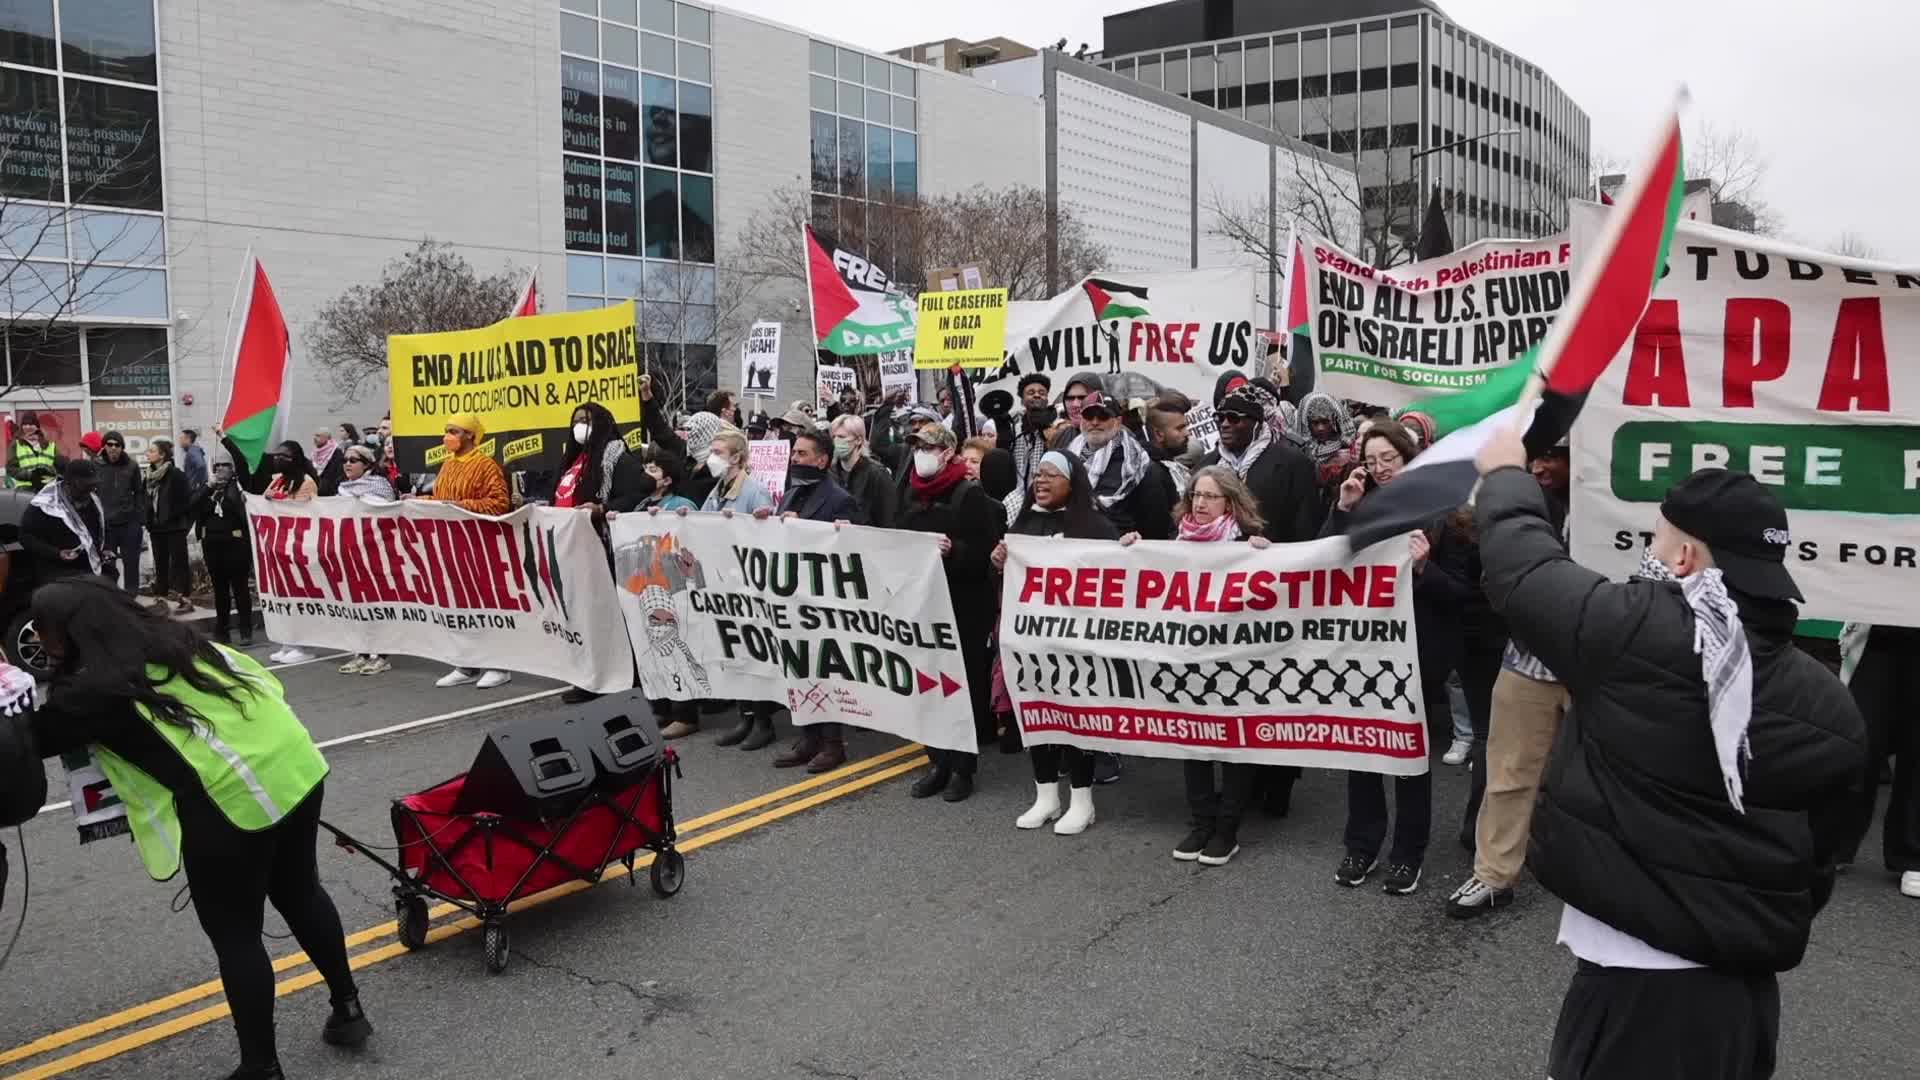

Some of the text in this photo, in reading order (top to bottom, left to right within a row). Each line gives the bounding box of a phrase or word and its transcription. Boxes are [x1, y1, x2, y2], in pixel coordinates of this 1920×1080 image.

[563, 89, 580, 105] my
[67, 126, 91, 138] was
[94, 128, 142, 144] possible
[563, 107, 627, 132] Mastes in
[563, 129, 600, 150] Public
[564, 159, 633, 182] Adminiration
[564, 181, 575, 196] in
[577, 182, 591, 199] 18
[565, 206, 588, 221] and
[565, 228, 628, 247] graduted
[1314, 246, 1375, 279] Stand
[1436, 249, 1552, 288] Palestinian
[921, 296, 944, 312] FULL
[947, 293, 1003, 310] CEASEFIRE
[1319, 268, 1364, 312] END
[1373, 285, 1424, 324] ALL
[1434, 284, 1482, 323] U.S.
[938, 314, 981, 330] IN GAZA
[943, 335, 974, 350] NOW!
[1029, 323, 1102, 372] WILL
[1128, 321, 1200, 363] FREE
[1208, 320, 1251, 367] US
[1354, 316, 1463, 366] ISRAELI
[412, 354, 452, 387] END
[457, 351, 485, 385] ALL
[504, 338, 546, 377] AID
[549, 335, 583, 374] TO
[1325, 357, 1488, 388] PARTY FOR SOCIALISM
[413, 373, 636, 416] NO TO OCCUPATON & APARTHEI
[427, 447, 452, 461] ANSW
[1639, 442, 1843, 487] FREE
[318, 515, 532, 612] PALESTINE!
[1839, 544, 1917, 568] FOR
[733, 545, 868, 600] YOUTH
[1019, 565, 1398, 613] FREE PALESTINE
[261, 599, 516, 630] PATY FOR SOCIALISM AND LIERATION
[753, 598, 791, 629] TE
[799, 604, 957, 650] STRUGGLE
[1014, 615, 1406, 646] UNTIL LIBERATION AND RETURN
[1023, 708, 1418, 752] MARYLAND 2 PALESTINE @MD2PALESTINE
